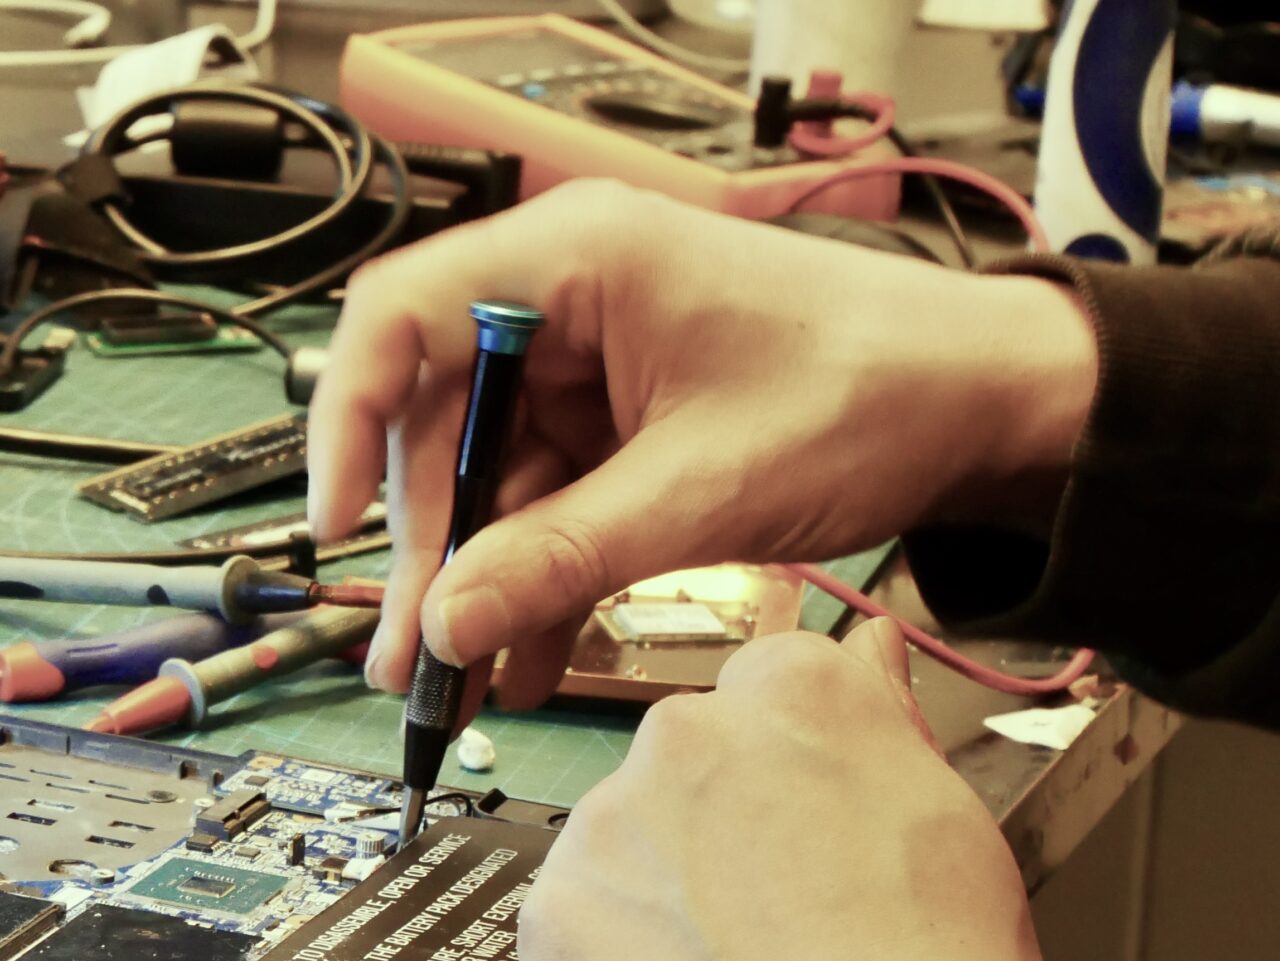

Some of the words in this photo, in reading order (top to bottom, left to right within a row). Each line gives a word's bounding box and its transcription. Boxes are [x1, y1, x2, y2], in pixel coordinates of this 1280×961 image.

[418, 833, 471, 865] SERVICE
[403, 865, 434, 877] OR
[377, 876, 419, 898] OPEN
[363, 943, 402, 961] THE
[384, 912, 441, 946] BATTERY
[425, 891, 468, 915] PACK
[449, 848, 518, 894] DESIGNATED
[308, 899, 396, 951] DISASSEMBLE,
[450, 919, 497, 947] SHORT
[292, 949, 325, 961] TO
[469, 930, 517, 959] WATER
